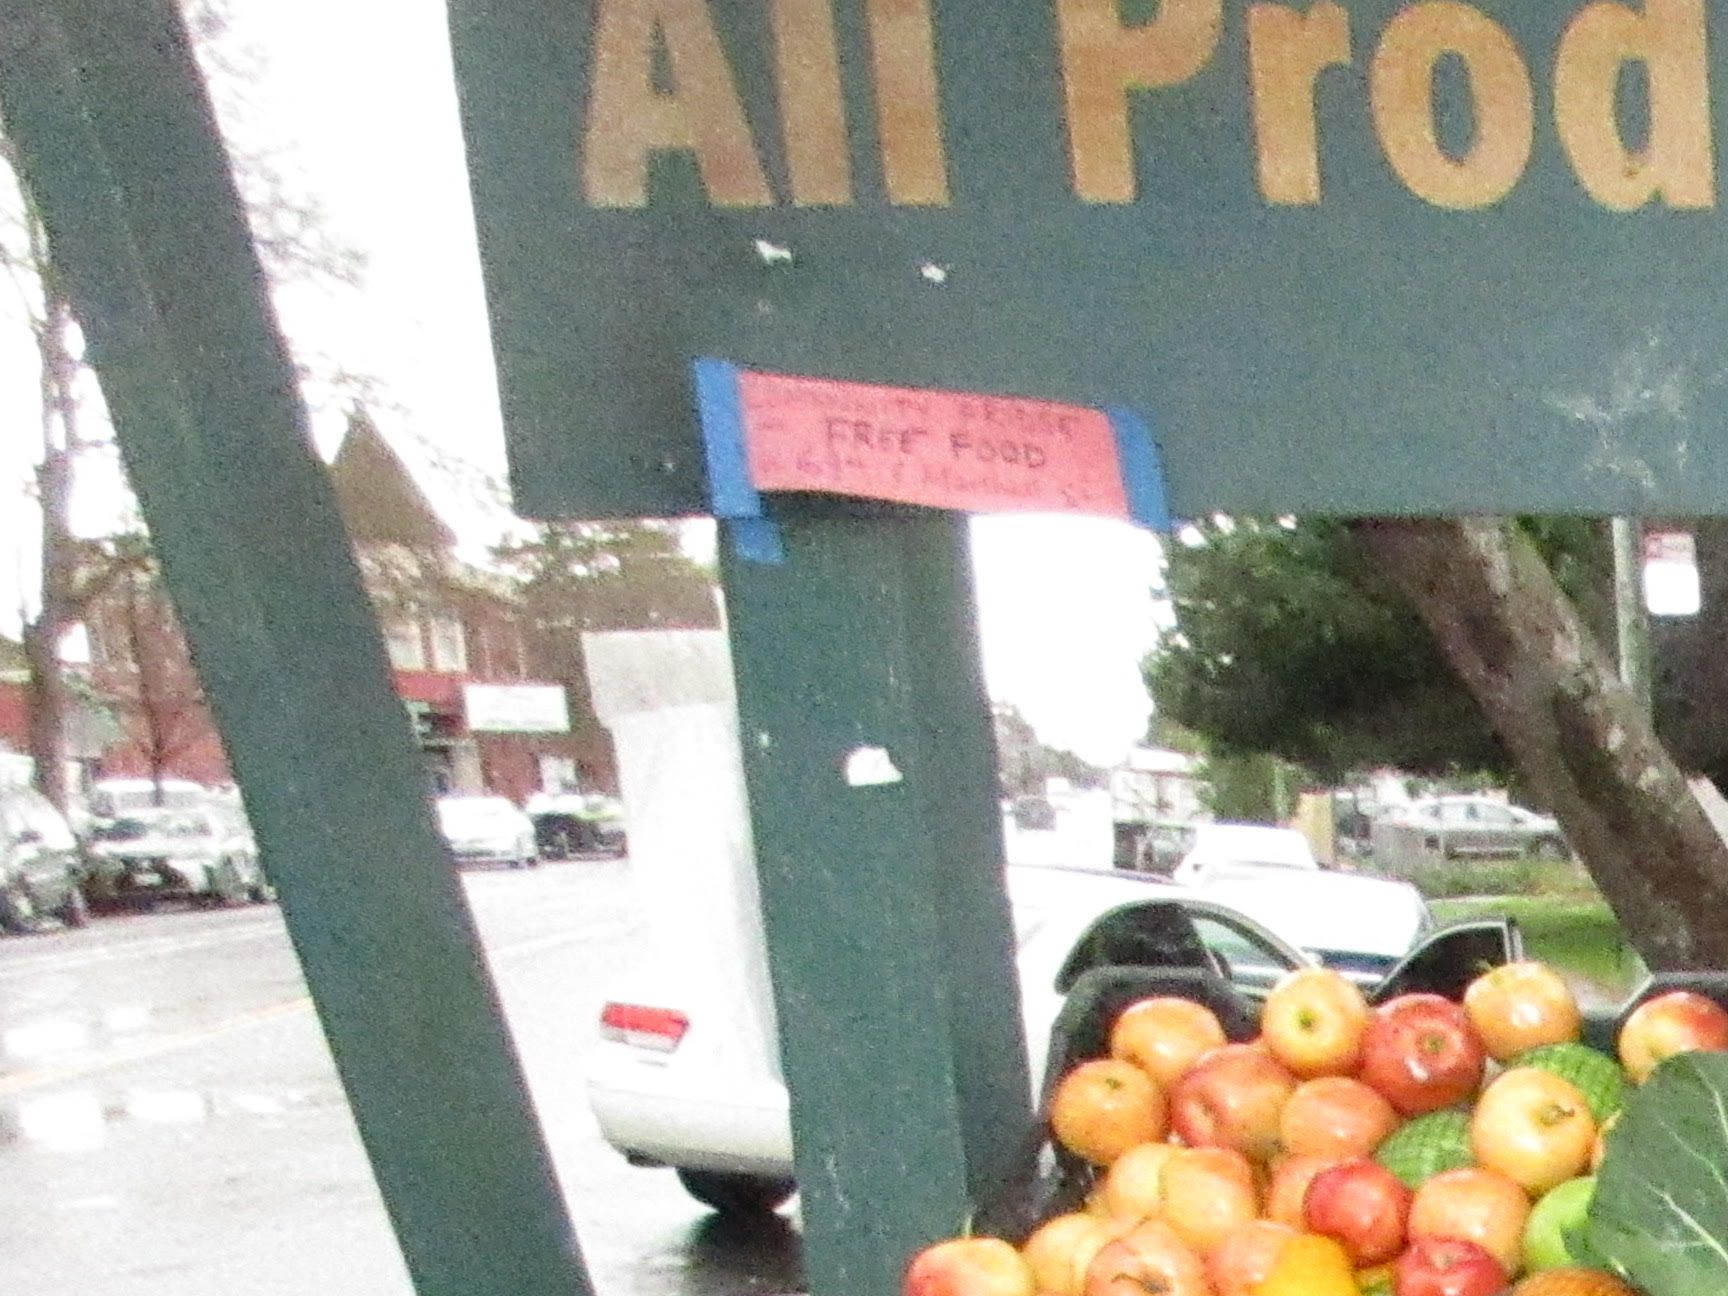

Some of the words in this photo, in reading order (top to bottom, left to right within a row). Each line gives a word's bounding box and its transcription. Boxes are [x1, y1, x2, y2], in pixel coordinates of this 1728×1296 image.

[584, 0, 949, 208] All
[826, 416, 928, 456] FREE
[949, 431, 1046, 468] FOOD
